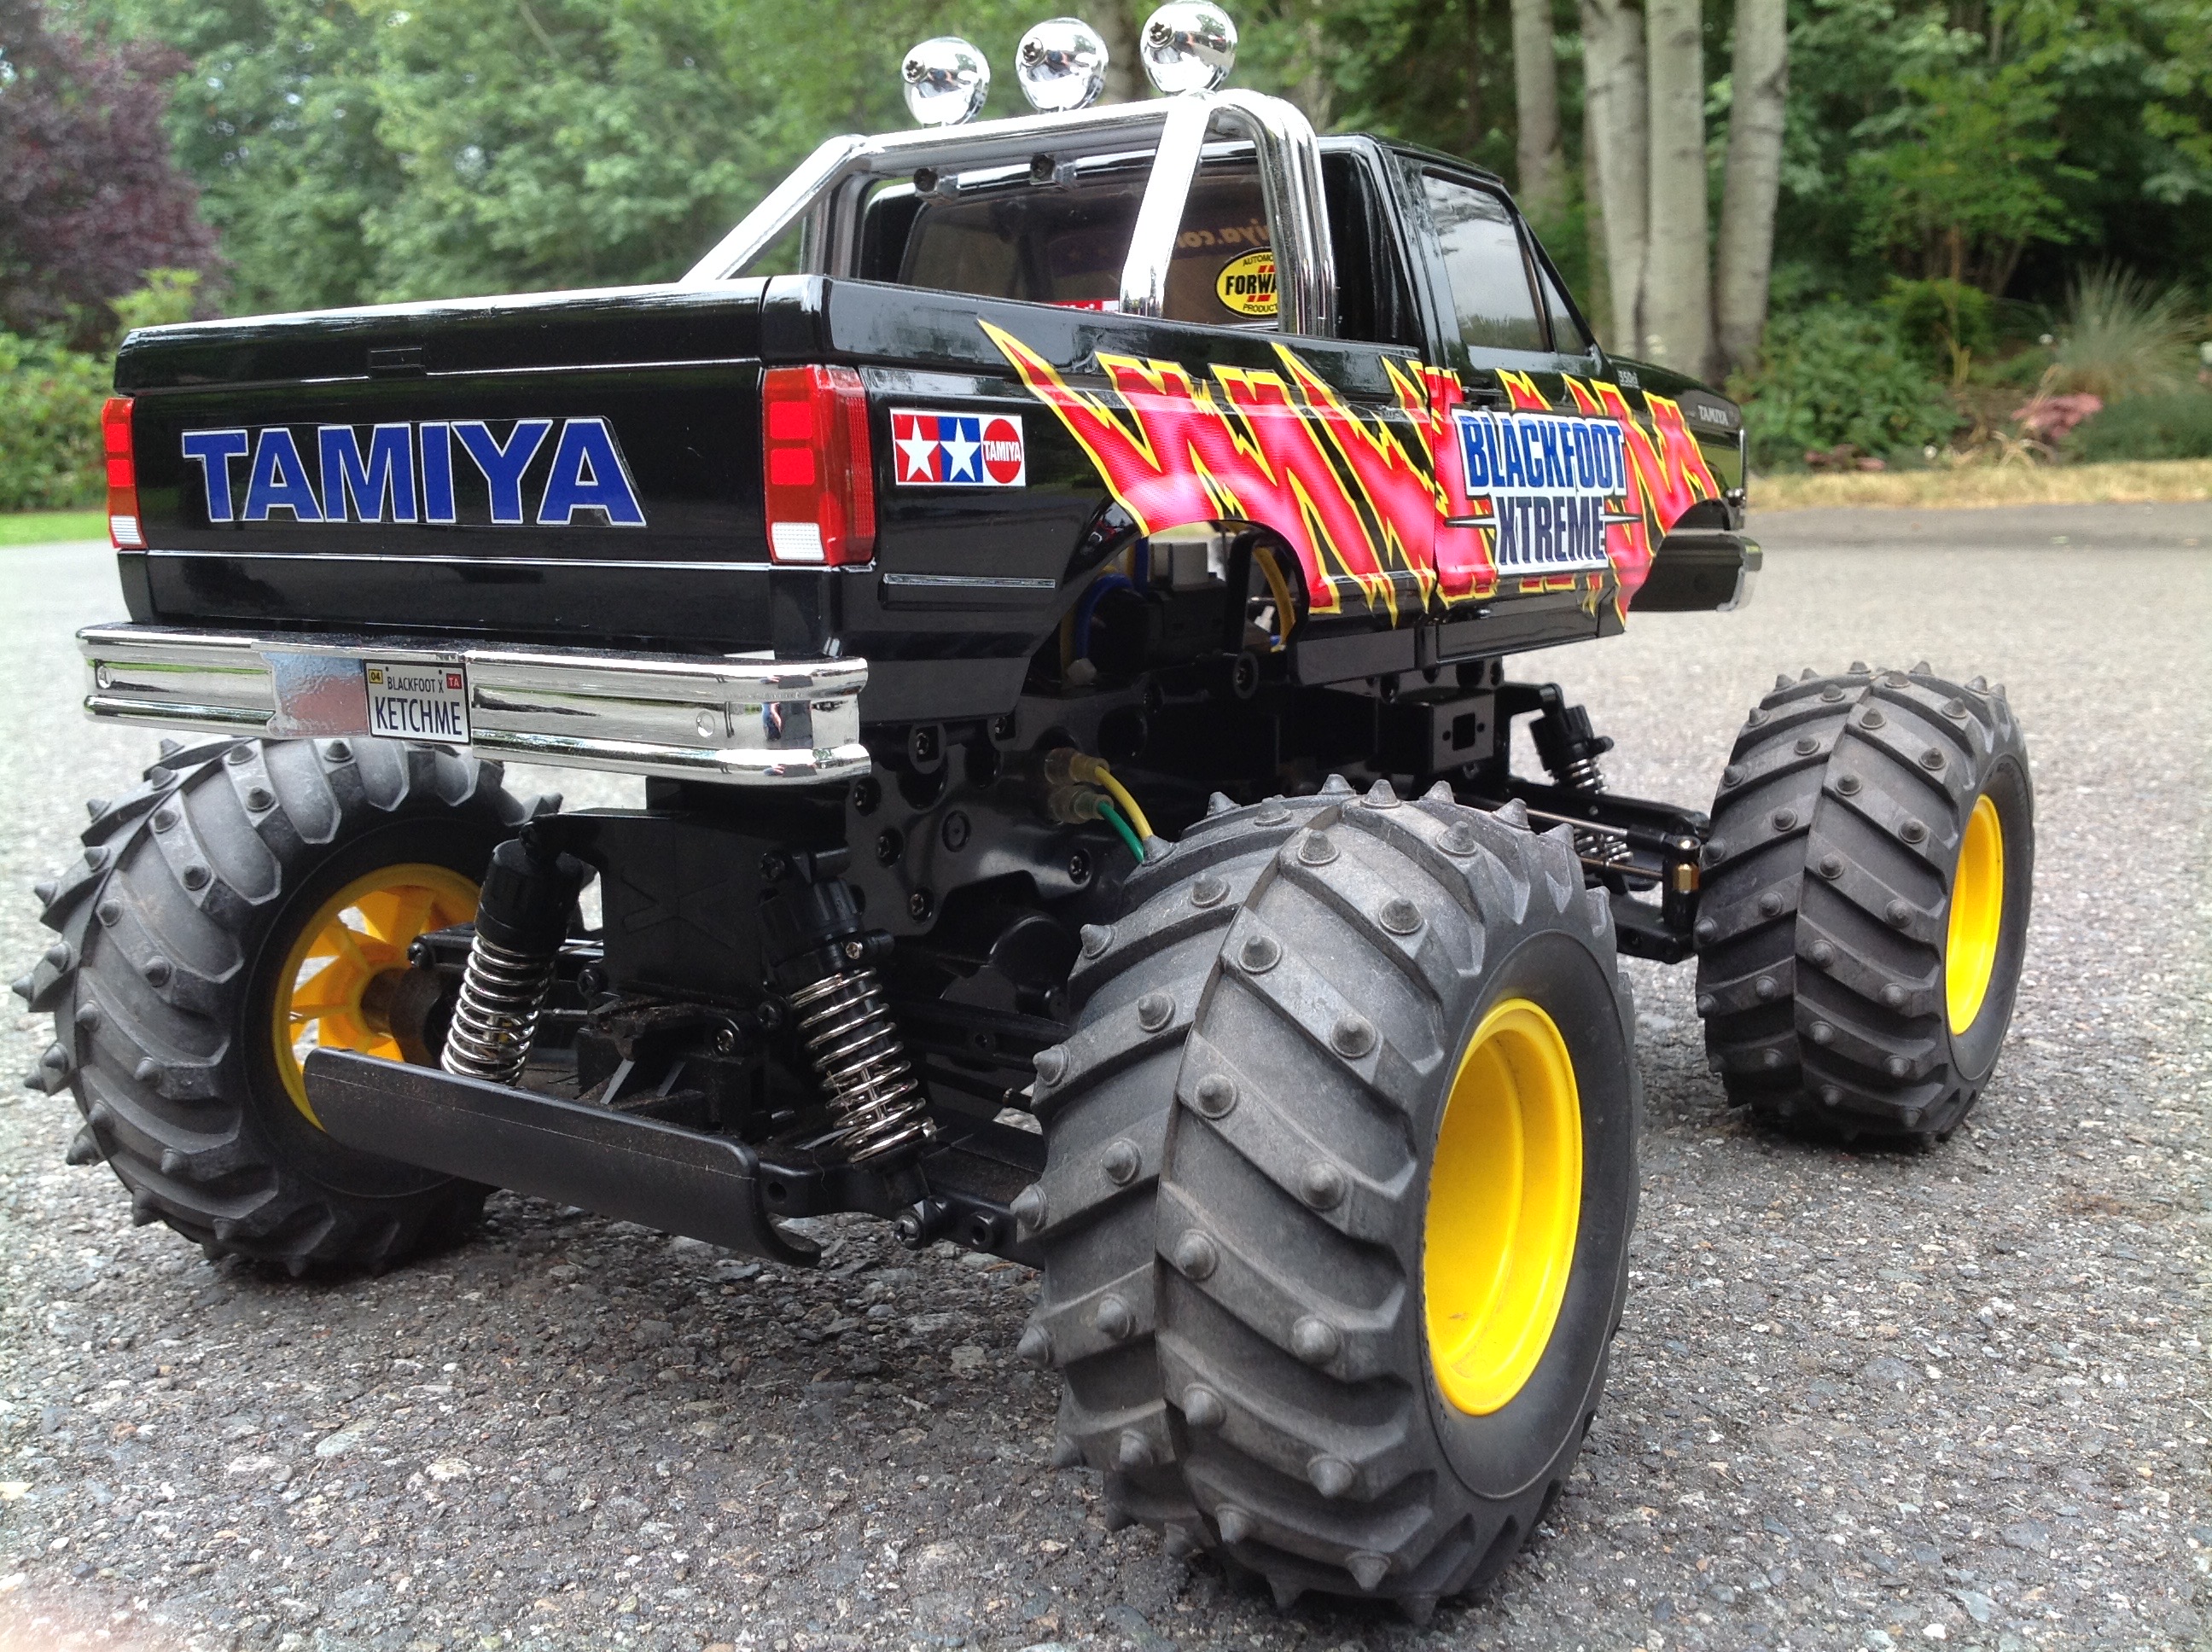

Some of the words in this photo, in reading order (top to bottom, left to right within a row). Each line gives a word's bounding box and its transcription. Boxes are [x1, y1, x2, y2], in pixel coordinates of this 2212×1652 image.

[983, 440, 1022, 462] TAMIYA
[1458, 415, 1625, 488] BLACKFOOT
[181, 418, 647, 526] TAMIYA
[1495, 495, 1607, 566] XTREME
[370, 672, 381, 681] 04
[387, 677, 436, 692] BLACKFOOT
[439, 679, 444, 693] X
[448, 678, 460, 687] TA
[375, 696, 463, 736] KETCHME
